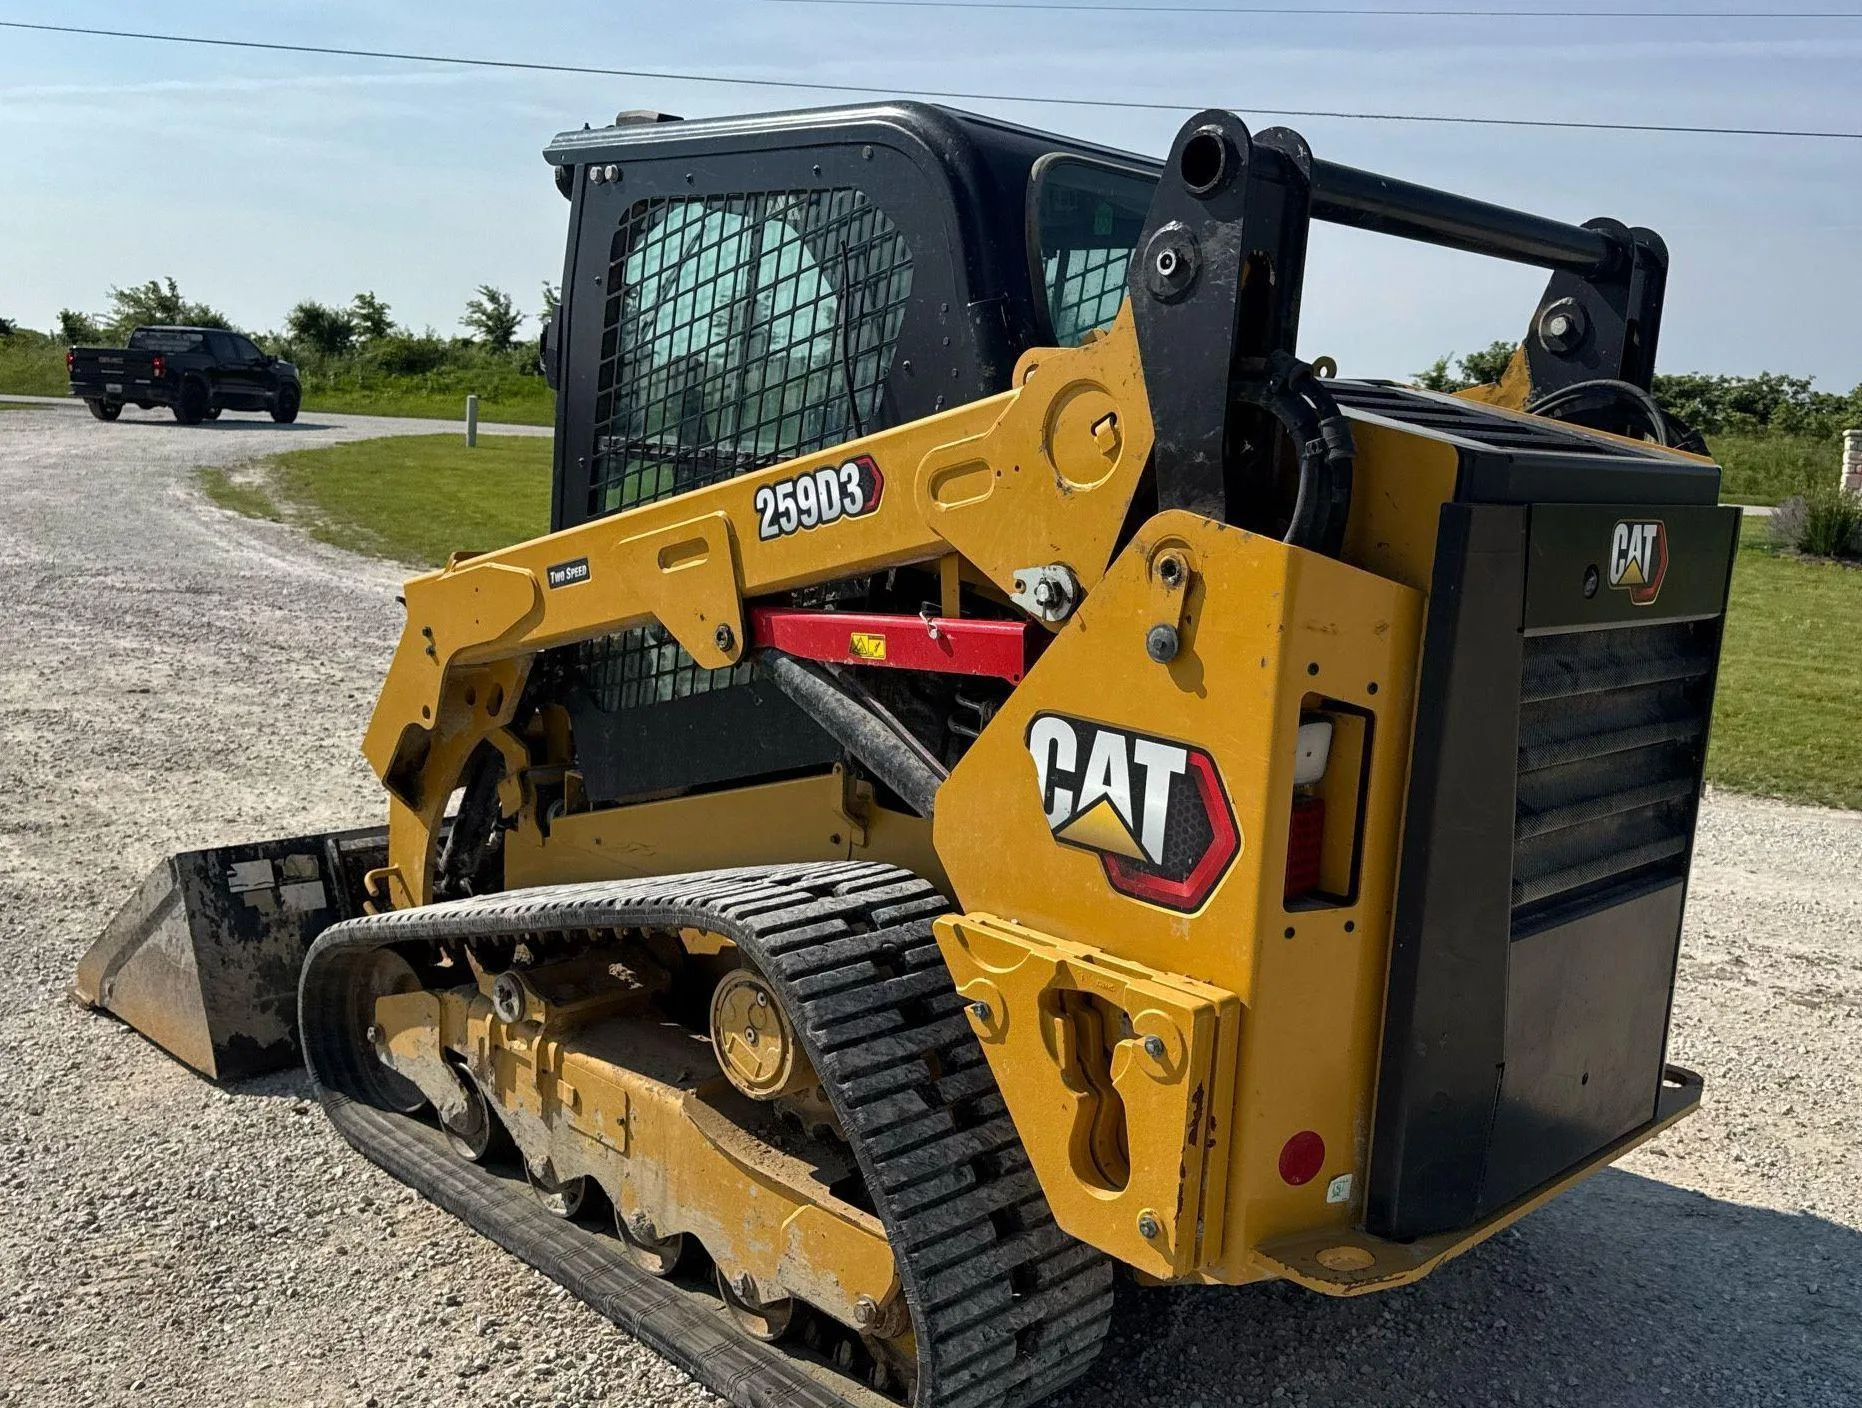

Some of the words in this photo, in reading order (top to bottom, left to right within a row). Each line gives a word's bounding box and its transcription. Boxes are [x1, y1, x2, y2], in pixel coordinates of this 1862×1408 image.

[756, 462, 864, 538] 259D3
[1610, 523, 1658, 585] CAT
[1030, 716, 1187, 865] CAT
